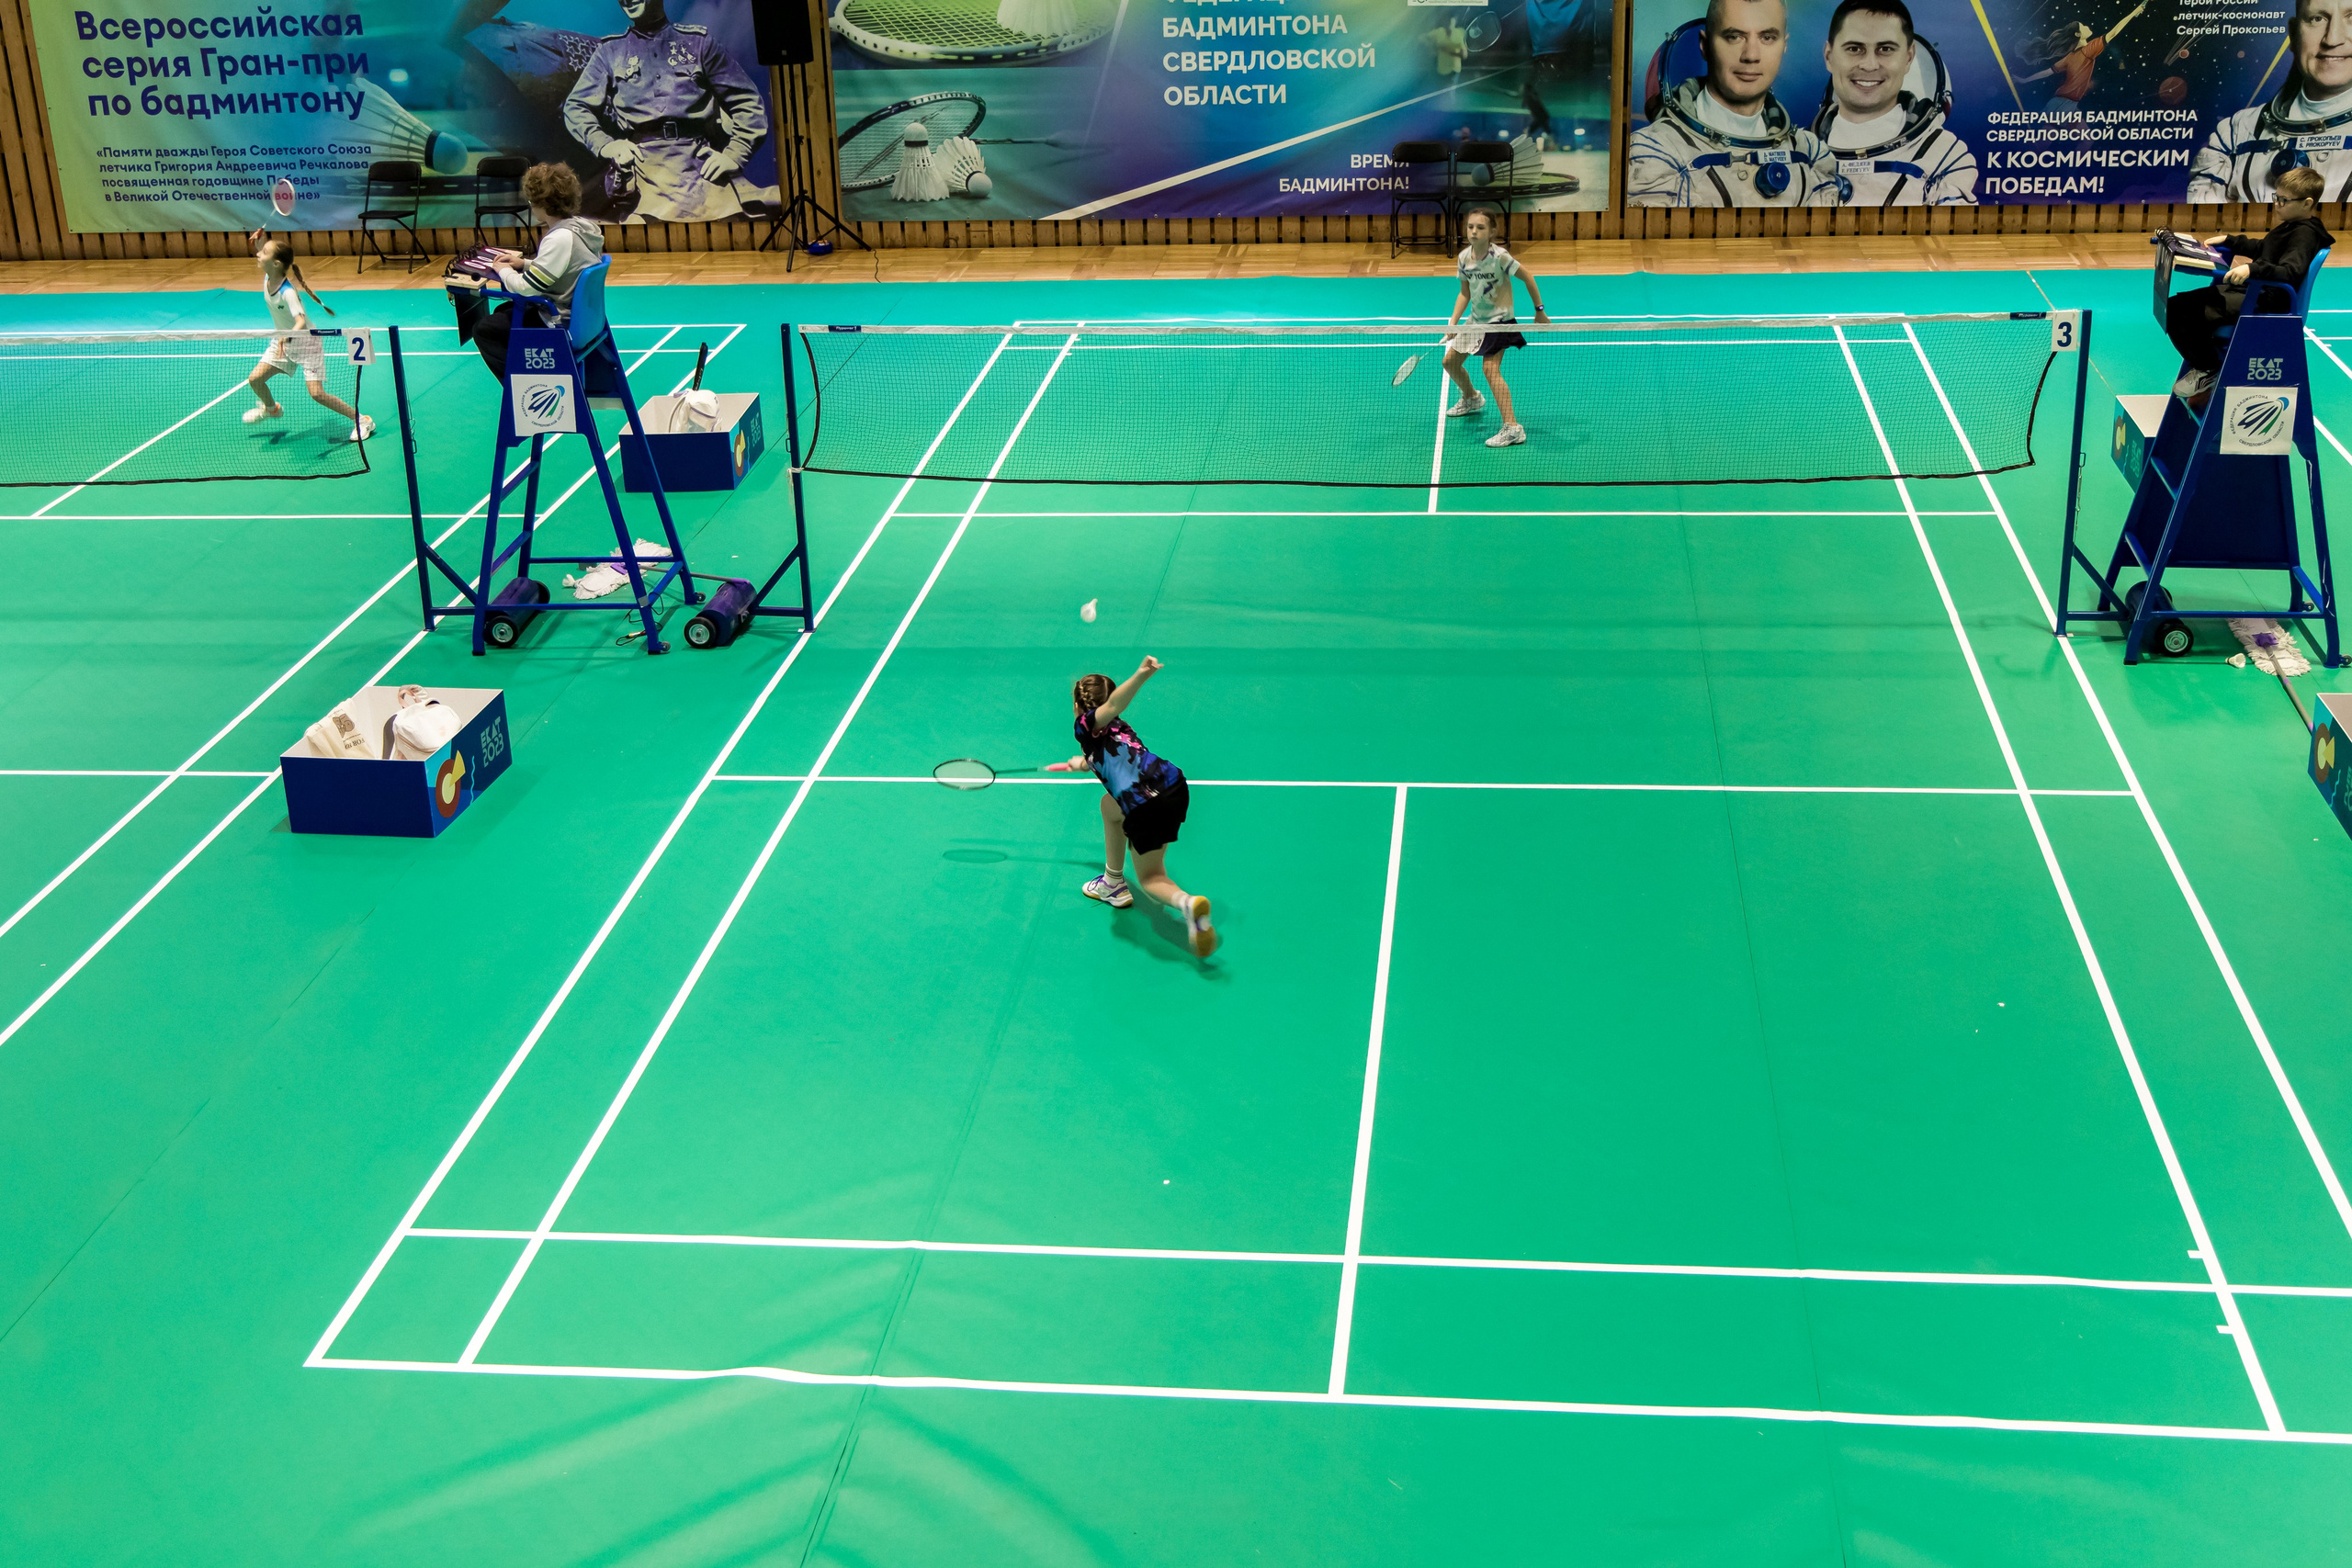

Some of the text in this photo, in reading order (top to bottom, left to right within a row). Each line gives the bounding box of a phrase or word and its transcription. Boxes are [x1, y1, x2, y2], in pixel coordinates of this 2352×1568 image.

[2177, 11, 2285, 20] летчик-космонавт
[74, 6, 364, 48] Всероссийская
[1162, 14, 1348, 40] БАДМИНТОНА
[2177, 24, 2286, 37] Сергей Прокопьев
[82, 48, 369, 85] серия Гран-при
[1162, 42, 1375, 73] СВЕРДЛОВСКОЙ
[88, 85, 366, 120] по бадминтону
[1163, 84, 1286, 106] ОБЛАСТИ
[1987, 109, 2198, 126] ФЕДЕРАЦИЯ БАДМИНТОНА
[1986, 126, 2194, 143] СВЕРДЛОВСКОЙ ОБЛАСТИ
[96, 143, 371, 159] «Памяти дважды Героя Советского Союза
[1987, 150, 2189, 168] К КОСМИЧЕСКИМ
[99, 159, 369, 174] летчика Григория Андреевича Речкалова
[102, 178, 189, 188] посвященная
[192, 177, 264, 187] годовщине
[1279, 176, 1409, 194] БАДМИНТОНА!
[1985, 176, 2105, 197] ПОБЕДАМ!
[105, 193, 111, 201] в
[114, 190, 168, 202] Великой
[172, 189, 271, 201] Отечественной
[2057, 321, 2072, 347] 3
[351, 336, 366, 361] 2
[524, 348, 554, 357] EKAT
[525, 358, 555, 368] 2023
[2248, 357, 2284, 367] EKAT
[2247, 368, 2282, 380] 2023
[481, 716, 501, 749] EKAT
[482, 732, 504, 768] 2023
